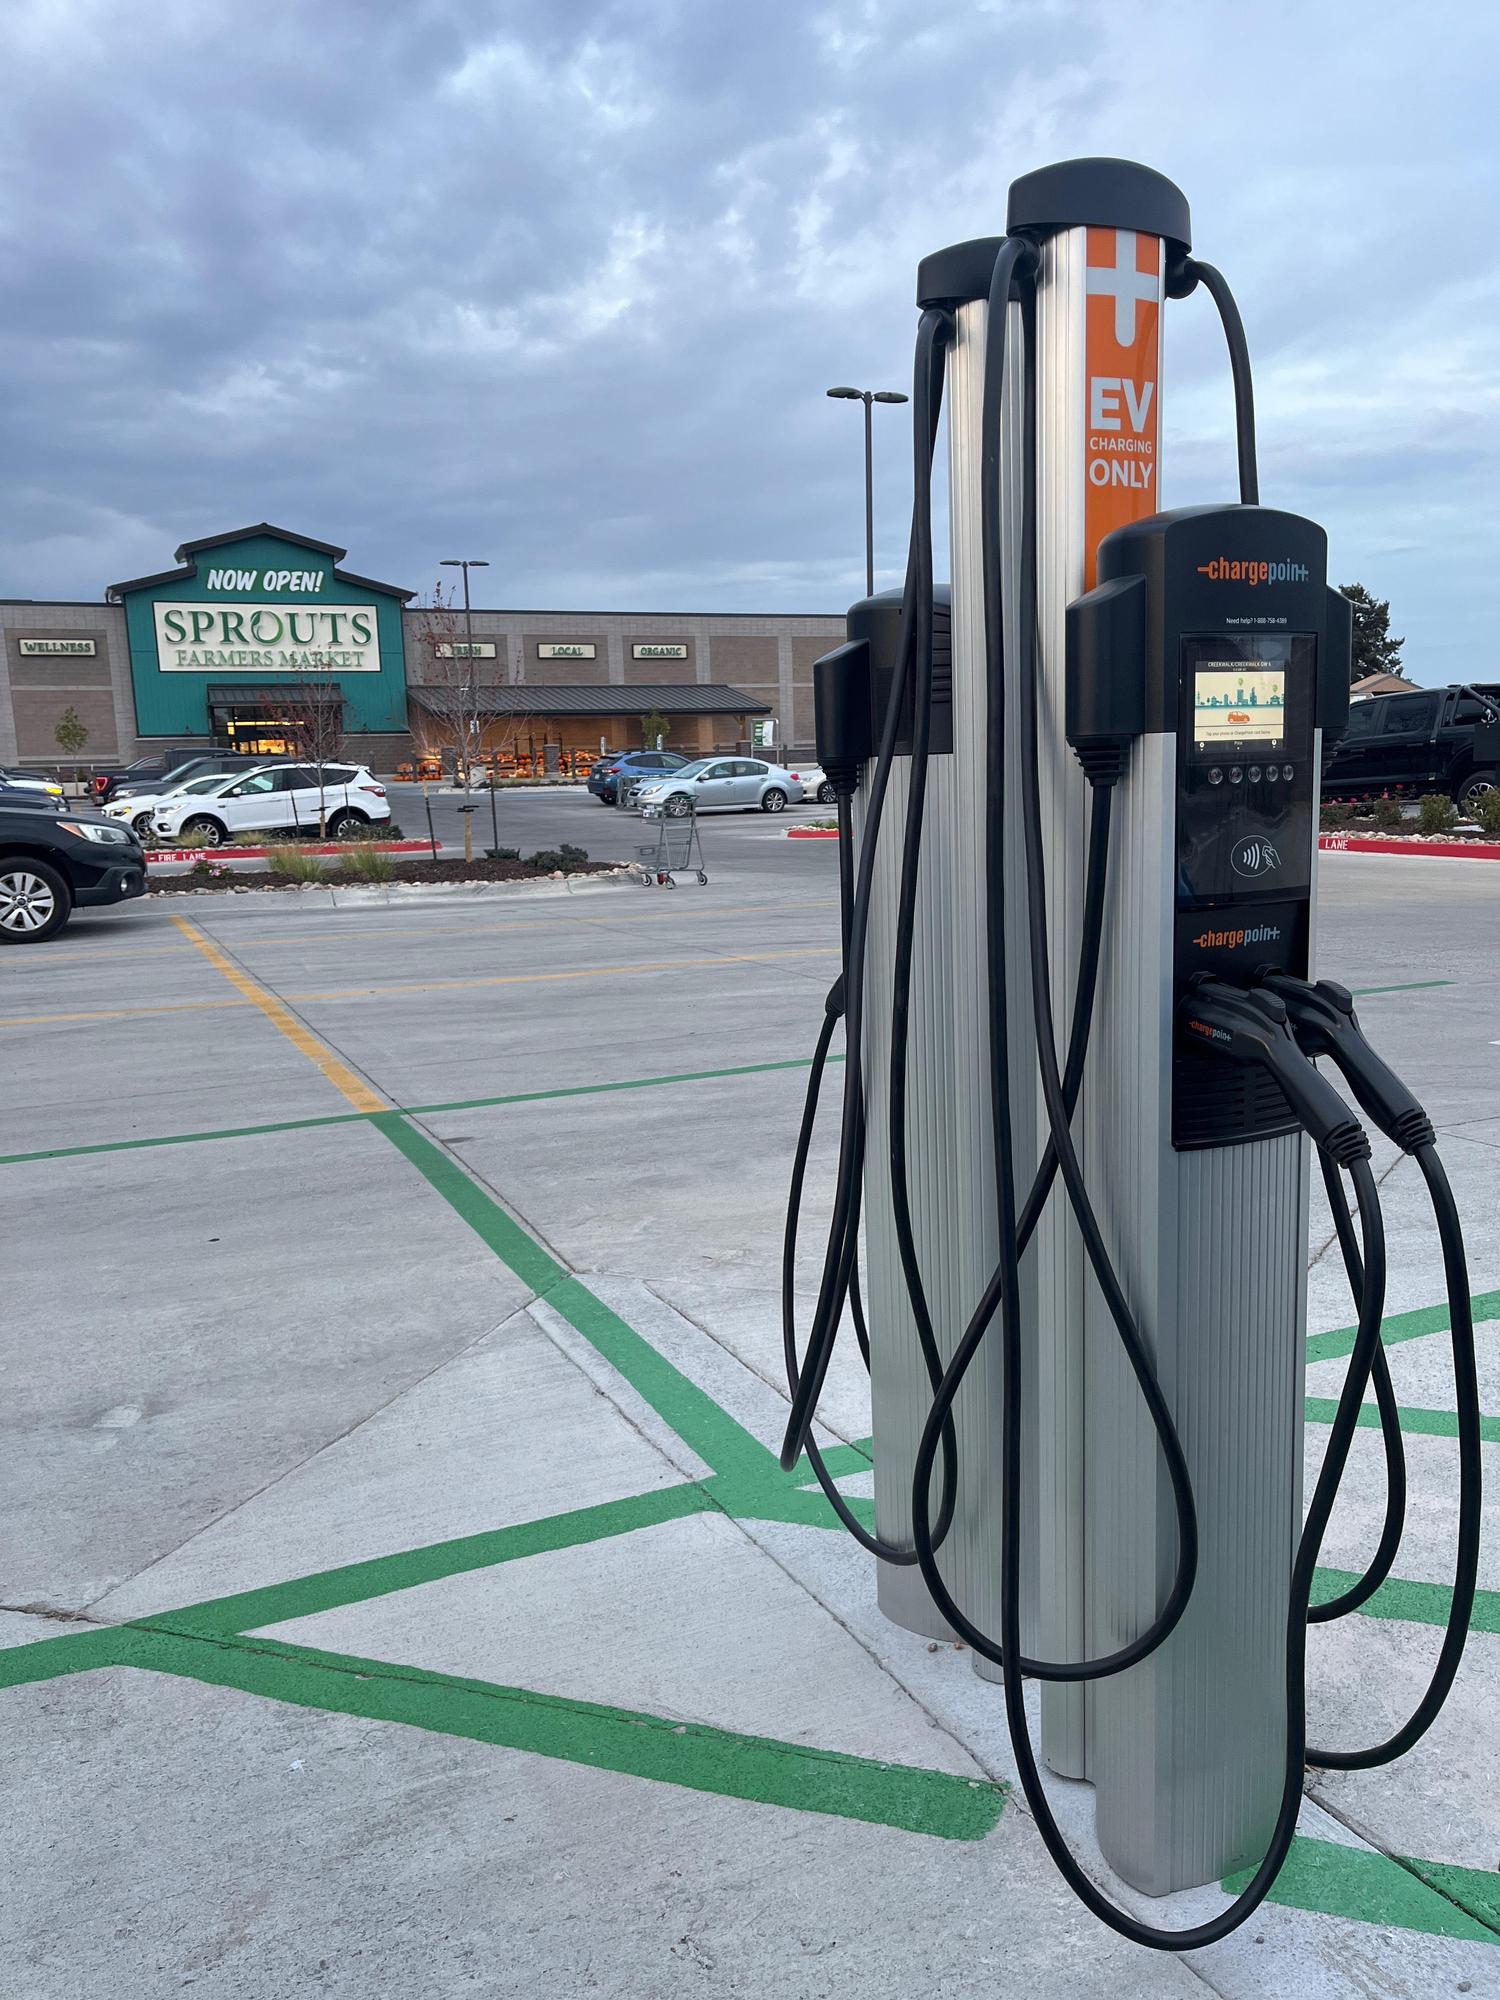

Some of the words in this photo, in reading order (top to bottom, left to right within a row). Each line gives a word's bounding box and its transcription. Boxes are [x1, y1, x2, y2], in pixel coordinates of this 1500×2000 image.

[1090, 376, 1154, 433] EV
[1089, 437, 1152, 454] CHARGING
[1089, 458, 1153, 489] ONLY
[207, 569, 258, 592] NOW
[263, 570, 324, 593] OPEN!
[164, 609, 372, 646] SPROUTS
[23, 642, 91, 653] WELLNESS
[552, 646, 584, 656] LOCAL
[640, 647, 682, 656] ORGANIC
[176, 649, 273, 667] FARMERS
[279, 651, 365, 668] MARKET
[1325, 839, 1348, 850] LANE
[158, 853, 177, 862] FIRE
